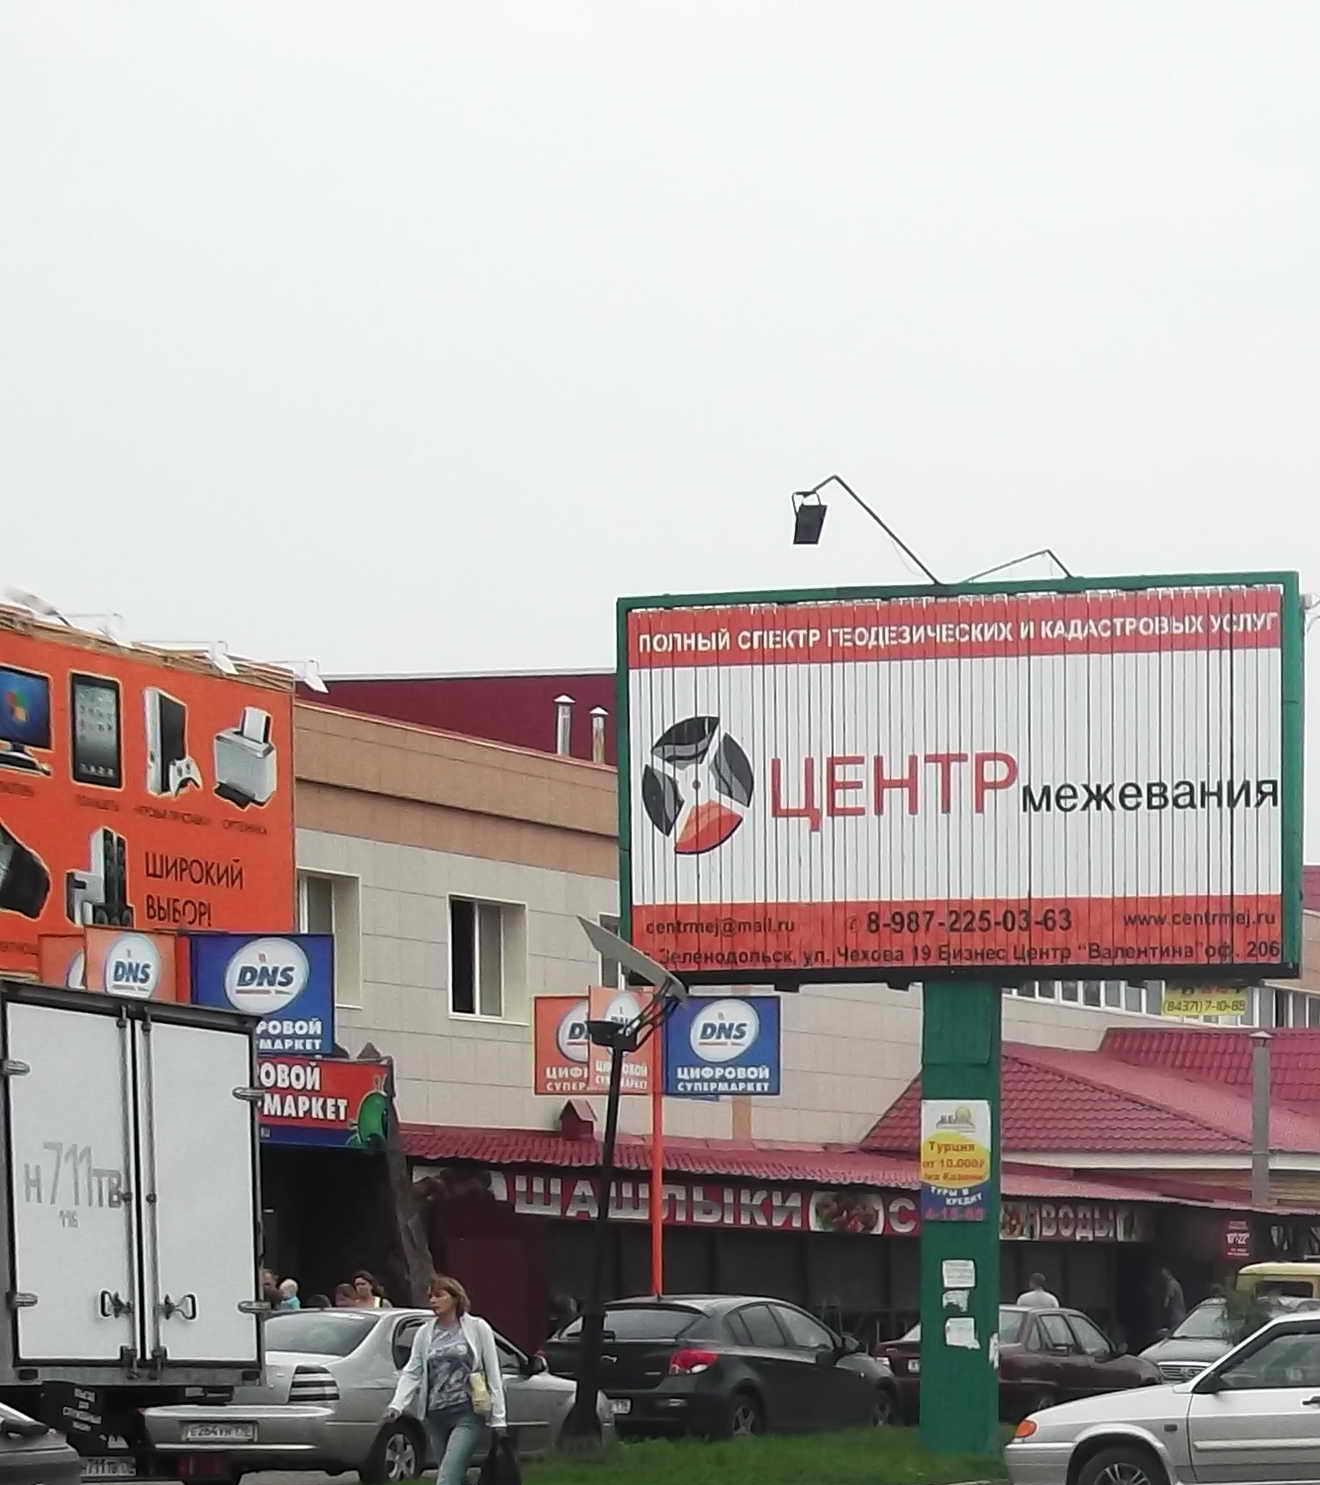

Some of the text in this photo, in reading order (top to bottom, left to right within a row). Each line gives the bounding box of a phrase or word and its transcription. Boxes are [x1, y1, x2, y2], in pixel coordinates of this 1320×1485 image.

[639, 612, 1279, 653] ПОЛНЫЙ СПЕКТР ГЕОДЕЗИЧЕСКИХ И КАДАСТРОВЫХ УСЛУГ
[770, 751, 1280, 832] ЦЕНТР межевания
[145, 852, 245, 890] ШИРОКИЙ
[146, 894, 213, 928] ВЫБОР!
[867, 908, 1073, 933] 8-987-225-03-63
[1123, 911, 1276, 929] www.centrmej.ru
[836, 945, 904, 963] Чехова
[938, 944, 1008, 962] Бизнес
[1014, 944, 1072, 966] Центр
[1247, 941, 1281, 958] 206
[114, 960, 151, 985] DNS
[237, 965, 295, 988] DNS
[700, 1022, 748, 1040] DNS
[257, 1039, 322, 1050] МАРКЕТ
[258, 1062, 321, 1091] ОВОЙ
[677, 1064, 770, 1082] ЦИФРОВОЙ
[677, 1081, 769, 1092] СУПЕРМАРКЕТ
[258, 1094, 348, 1121] МАРКЕТ
[514, 1174, 802, 1228] ШАШЛЫКИ
